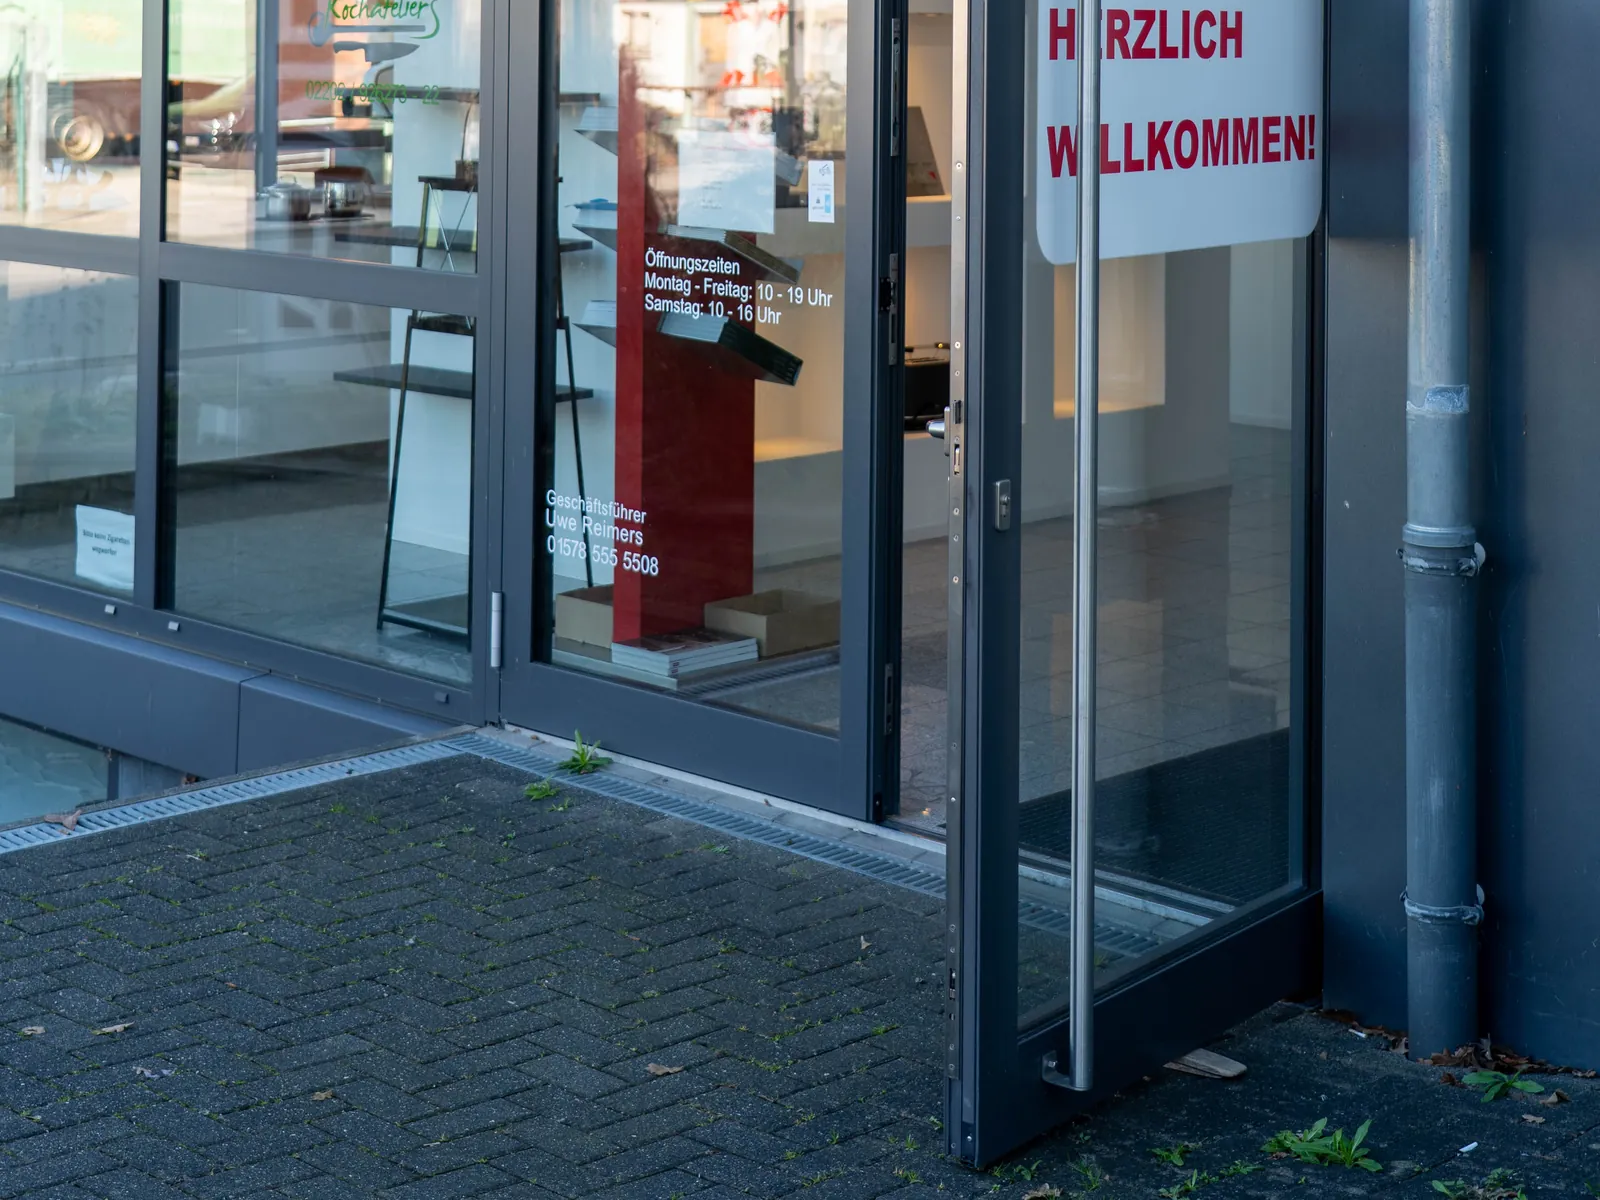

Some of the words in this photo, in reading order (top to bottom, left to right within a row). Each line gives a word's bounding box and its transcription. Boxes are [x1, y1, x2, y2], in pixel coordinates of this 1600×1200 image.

[1048, 7, 1244, 61] HRZLICH
[1047, 114, 1316, 179] WLLKOMMEN!
[644, 247, 741, 276] Öffnungszeiten
[644, 271, 691, 296] Montag
[703, 277, 753, 303] Freitag:
[757, 283, 774, 301] 10
[786, 286, 804, 305] 19
[807, 287, 833, 307] Uhr
[644, 293, 704, 319] Samstag:
[708, 300, 724, 318] 10
[737, 304, 754, 322] 16
[757, 306, 782, 325] Uhr
[546, 489, 647, 524] Geschäftsführer
[546, 508, 577, 531] Uwe
[582, 515, 644, 545] Reimers
[547, 534, 587, 559] 01578
[592, 544, 619, 566] 555
[622, 551, 659, 576] 5508
